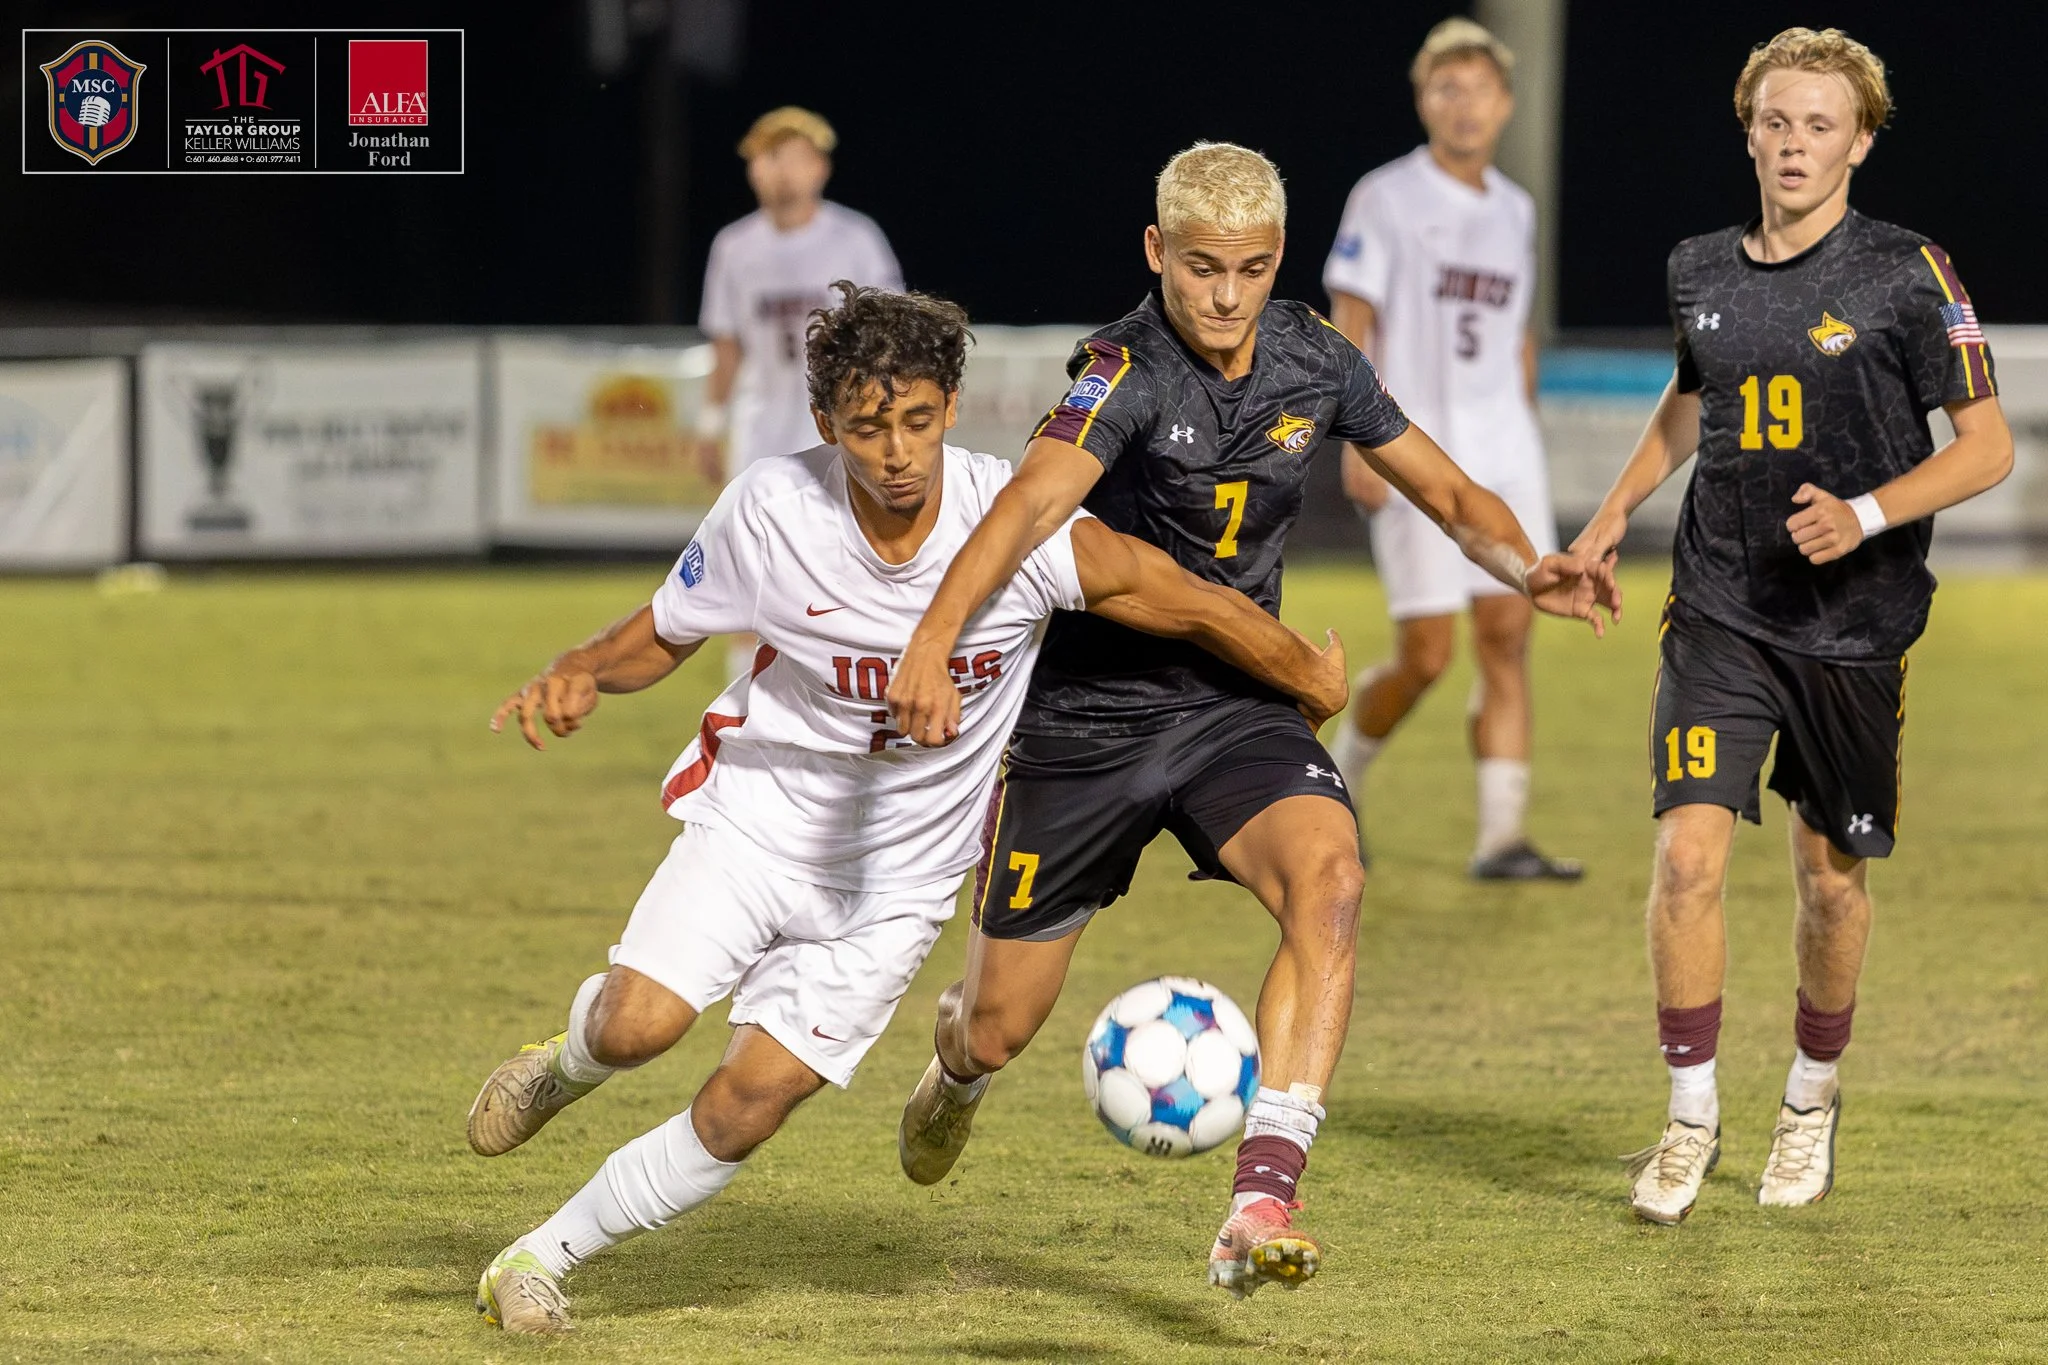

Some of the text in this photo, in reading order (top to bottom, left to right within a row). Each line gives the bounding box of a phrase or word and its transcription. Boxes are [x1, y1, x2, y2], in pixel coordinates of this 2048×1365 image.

[1455, 311, 1481, 361] 5
[1739, 374, 1803, 450] 19
[1214, 480, 1248, 558] 7
[825, 650, 1003, 701] JOES
[1665, 725, 1717, 782] 19
[1008, 851, 1040, 909] 7
